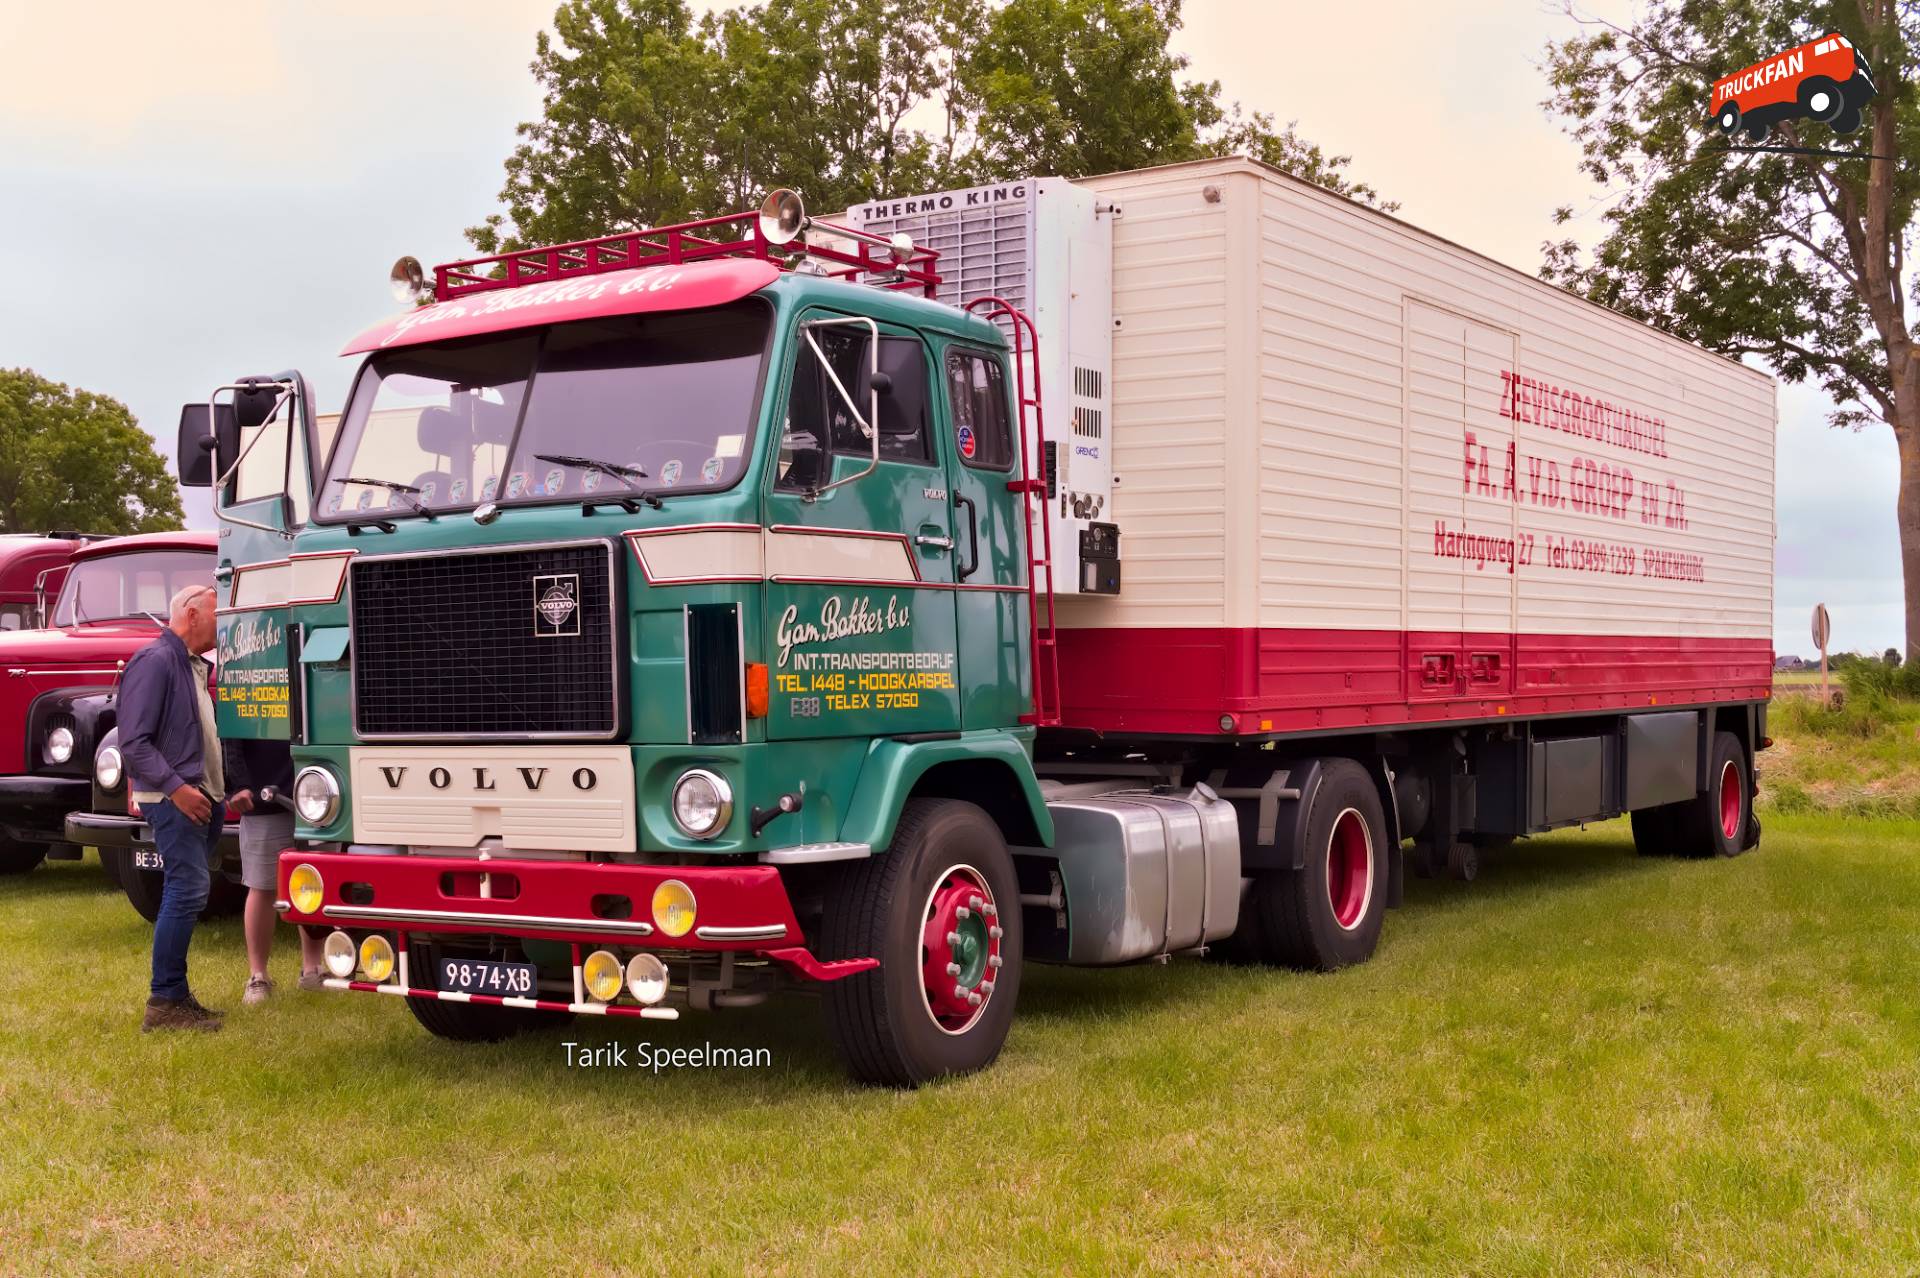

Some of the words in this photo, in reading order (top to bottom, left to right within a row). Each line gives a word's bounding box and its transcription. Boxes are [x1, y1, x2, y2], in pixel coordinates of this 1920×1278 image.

[863, 196, 953, 220] THERMO
[966, 185, 1026, 206] KING
[1499, 370, 1669, 459] ZEEVISGROOTHANDEL
[1570, 456, 1634, 520] GROEP
[1641, 481, 1659, 525] EN
[1434, 519, 1515, 574] Haringweg
[1518, 532, 1535, 566] 27
[541, 601, 572, 610] VOLVO
[820, 596, 884, 642] Bakker
[231, 687, 246, 701] 1448
[811, 673, 845, 692] 1448
[859, 672, 955, 691] HOOGKARSPEL
[237, 704, 259, 717] TELEX
[261, 704, 288, 717] 57050
[825, 693, 870, 711] TELEX
[876, 692, 919, 709] 57050
[379, 766, 598, 791] VOLVO
[446, 963, 532, 992] 98-74-XB
